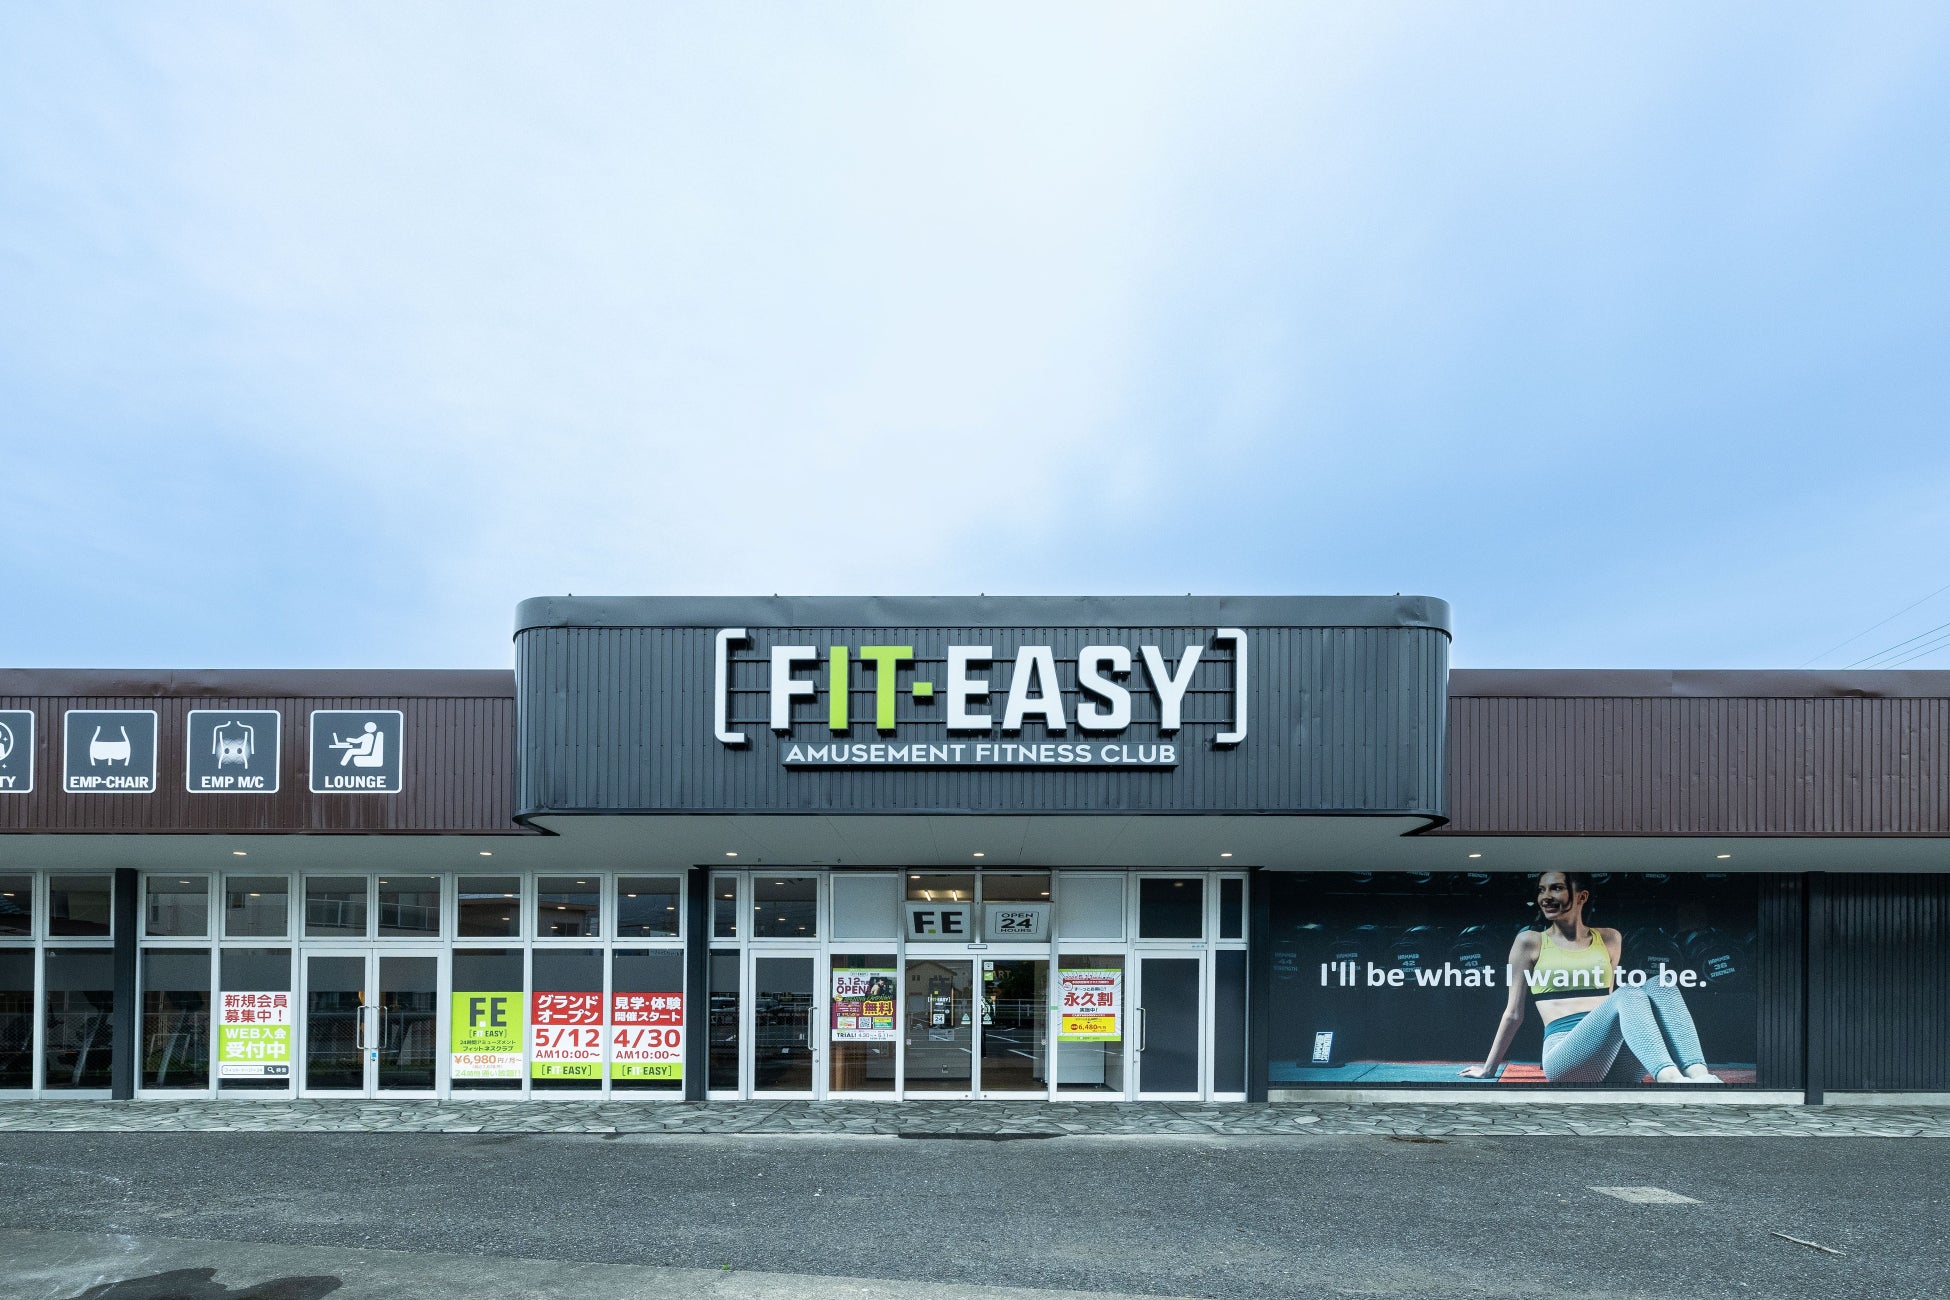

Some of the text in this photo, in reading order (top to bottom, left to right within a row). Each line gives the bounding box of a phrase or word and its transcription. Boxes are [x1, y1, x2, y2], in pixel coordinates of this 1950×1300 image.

[785, 744, 1176, 763] AMUSEMENT FITNESS CLUB
[70, 776, 149, 788] EMP-CHAIR
[201, 776, 264, 788] EMP M/C
[324, 776, 386, 788] LOUNGE
[1001, 918, 1032, 928] 24
[1321, 961, 1707, 987] I'll be what I want to be.
[225, 994, 287, 1008] 新規会員
[538, 994, 599, 1010] グランド
[615, 997, 682, 1010] 見学・体験
[1064, 991, 1113, 1007] 永久割
[863, 1001, 894, 1016] 無料
[225, 1009, 282, 1023] 募集中！
[538, 1009, 599, 1023] オープン
[615, 1011, 680, 1022] 開催スタート
[535, 1028, 600, 1047] 5/12
[614, 1029, 681, 1048] 4/30
[226, 1041, 286, 1059] 受付中
